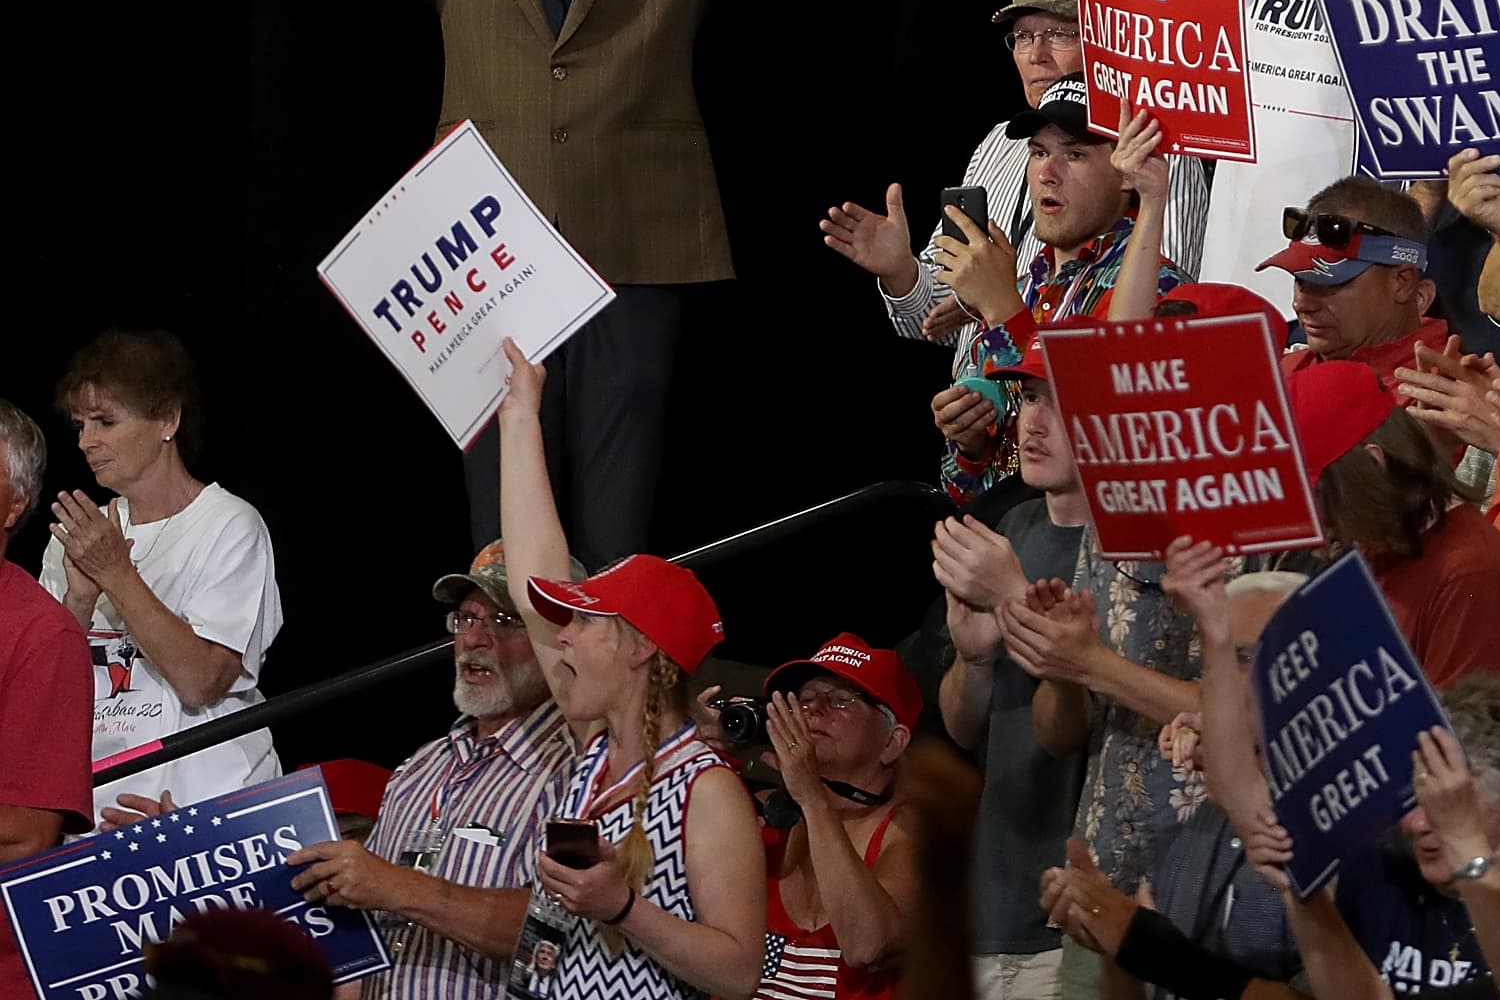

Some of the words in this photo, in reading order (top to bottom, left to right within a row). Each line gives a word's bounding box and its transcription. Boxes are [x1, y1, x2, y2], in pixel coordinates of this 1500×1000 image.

[1255, 22, 1269, 32] FOR
[1270, 26, 1312, 41] PRESIDENT
[1313, 34, 1329, 44] 201
[1093, 60, 1132, 100] GREAT
[1136, 79, 1229, 115] AGAIN
[1288, 69, 1315, 82] GREAT
[1417, 47, 1491, 86] THE
[1064, 91, 1087, 105] AGA
[373, 195, 502, 333] TRUMP
[411, 243, 516, 353] PENCE
[428, 353, 450, 375] MAKE
[446, 324, 474, 356] AMERICA
[471, 297, 498, 327] GREAT
[499, 264, 538, 300] AGAIN!
[1110, 358, 1190, 395] MAKE
[1071, 399, 1291, 465] AMERICA
[1096, 479, 1168, 514] GREAT
[1176, 467, 1285, 513] AGAIN
[825, 645, 871, 661] AMERICA
[1268, 630, 1320, 704] KEEP
[1269, 646, 1418, 800] MERICA
[1309, 744, 1390, 833] GREAT
[43, 824, 303, 933] PROMISES
